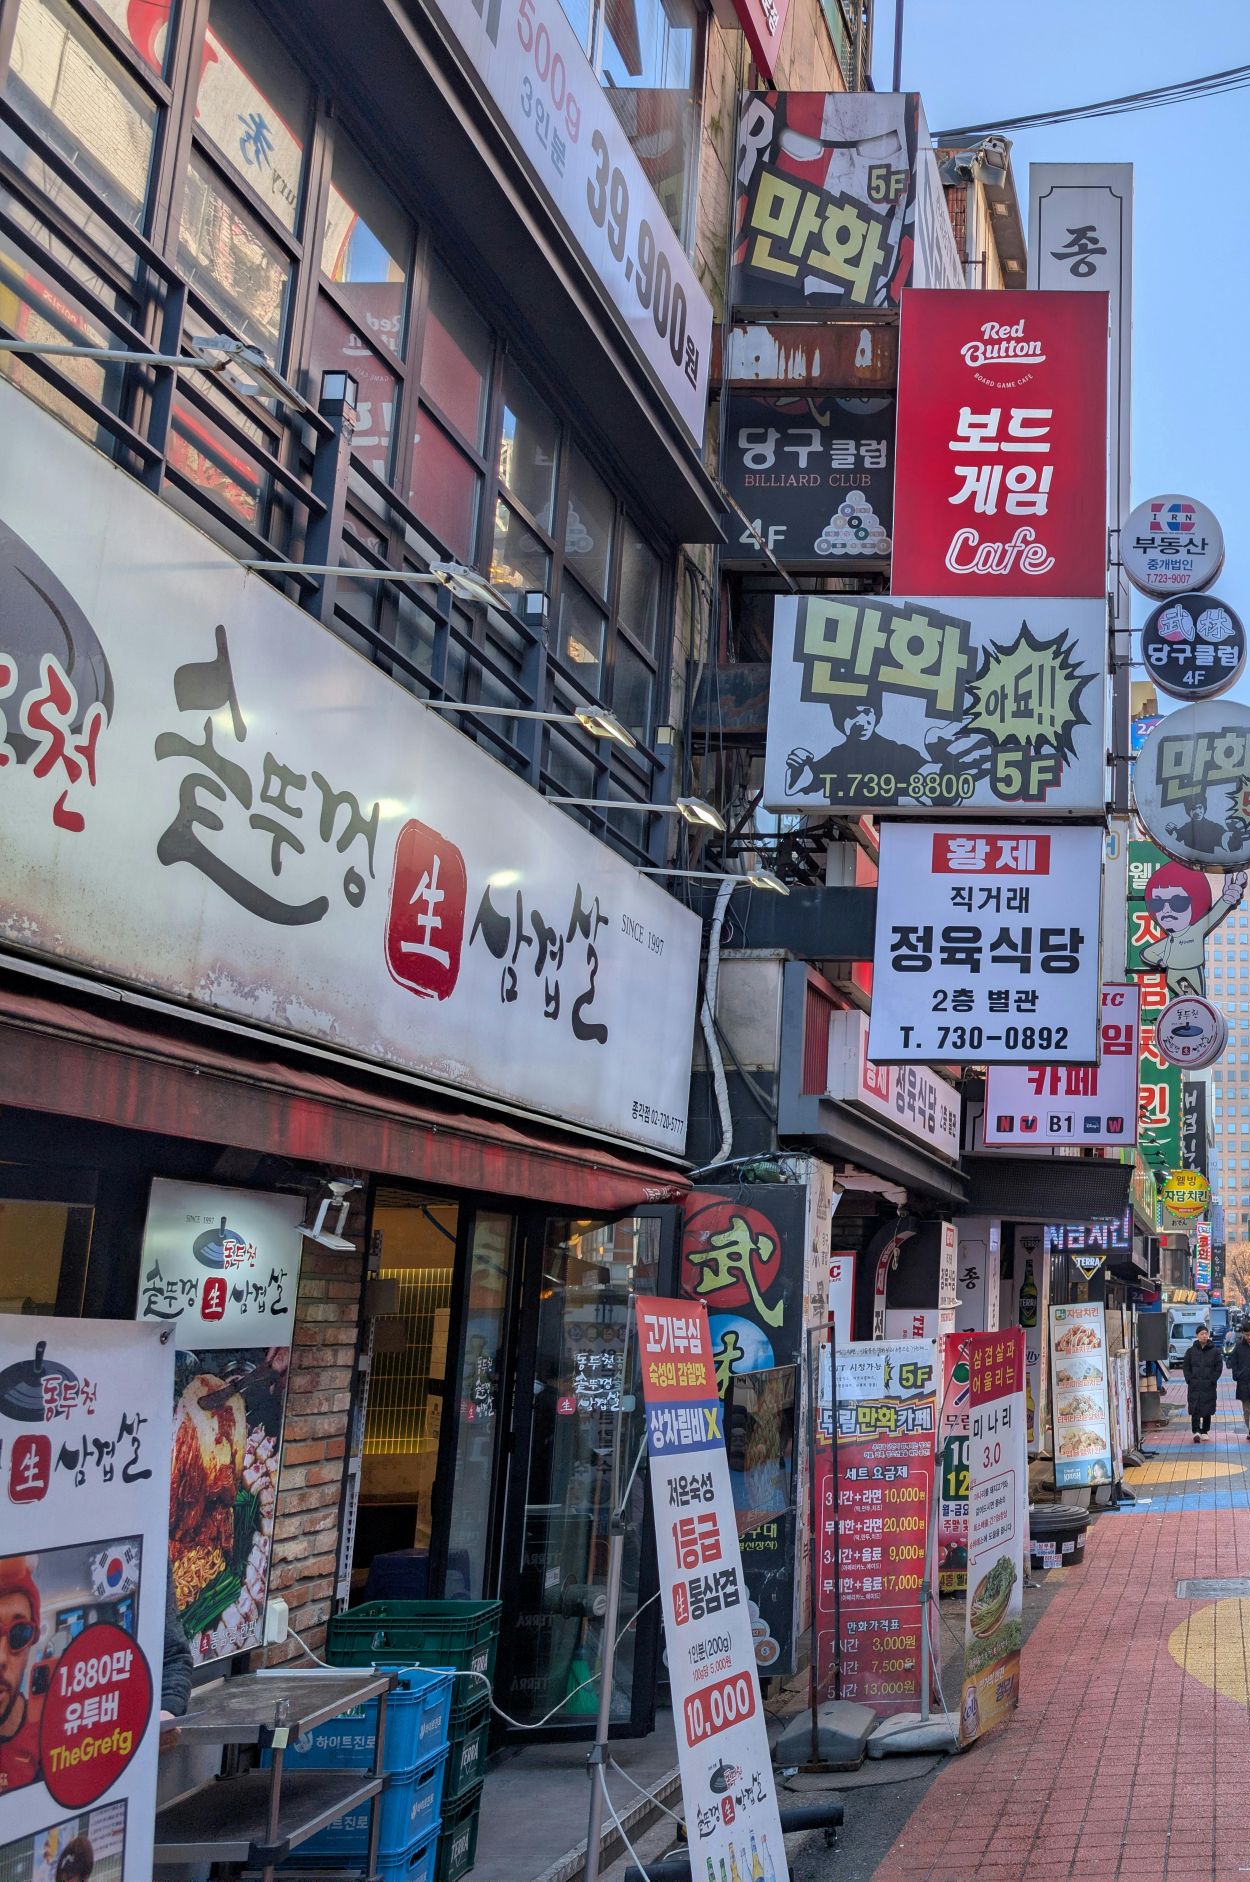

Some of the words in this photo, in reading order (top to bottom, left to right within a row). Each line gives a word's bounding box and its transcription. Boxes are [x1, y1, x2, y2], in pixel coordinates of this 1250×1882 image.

[868, 166, 906, 199] 5F
[751, 171, 885, 304] 만화
[980, 319, 1025, 340] Red
[960, 339, 1047, 367] Button
[974, 372, 996, 388] BOARD
[996, 380, 1016, 389] GAME
[1014, 373, 1034, 388] CAFE
[949, 406, 1053, 453] 보드
[745, 474, 820, 487] BILLIARD
[829, 474, 871, 487] CLUB
[949, 465, 1054, 516] 게임
[739, 518, 787, 551] 4F
[1133, 536, 1208, 556] 부동산
[945, 527, 1055, 574] Cafe
[1147, 558, 1193, 571] 중개법인
[1146, 573, 1191, 585] T.723-9007
[803, 597, 968, 711] 만화
[1148, 644, 1239, 667] 당구클럽
[1183, 670, 1206, 685] 4F
[820, 773, 974, 798] T.739-8800
[998, 752, 1058, 796] 5F
[154, 624, 380, 926] 솥뚜껑
[402, 855, 451, 966] 生
[469, 883, 608, 1044] 삼겹살
[946, 838, 1037, 871] 황제
[950, 887, 1031, 914] 직거래
[621, 914, 644, 945] SINCE
[647, 933, 665, 957] 1997
[890, 925, 1085, 974] 정육식당
[931, 989, 975, 1013] 2층
[988, 989, 1039, 1013] 별관
[937, 1026, 1069, 1050] 730-0892
[1028, 1066, 1098, 1096] 카페
[632, 1100, 651, 1123] 종각점
[651, 1107, 684, 1135] 02-720-5777
[1050, 1116, 1072, 1132] B1
[1165, 1190, 1208, 1202] 자담치킨
[223, 1240, 258, 1268] 동두천
[1077, 1257, 1101, 1267] TERRA
[143, 1260, 199, 1320] 솥뚜껑
[205, 1283, 223, 1314] 生
[230, 1268, 288, 1316] 삼겹살
[1067, 1308, 1100, 1318] 자담치킨
[644, 1314, 702, 1354] 고기부심
[973, 1342, 1015, 1368] 삼겹살과
[650, 1362, 676, 1387] 숙성의
[678, 1362, 706, 1387] 감칠맛
[900, 1363, 933, 1388] 5F
[973, 1368, 1014, 1394] 어울리는
[42, 1374, 97, 1424] 동두천
[973, 1405, 1012, 1439] 미나리
[15, 1443, 45, 1491] 生
[55, 1412, 153, 1488] 삼겹살
[983, 1442, 1001, 1468] 3.0
[845, 1467, 869, 1480] 세트
[872, 1466, 908, 1480] 요금제
[667, 1472, 715, 1507] 저온숙성
[884, 1488, 925, 1502] 10,000원
[884, 1517, 925, 1532] 20,000원
[672, 1512, 722, 1569] 1등급
[889, 1546, 924, 1560] 9,000원
[689, 1567, 740, 1620] 통삼겹
[847, 1619, 899, 1632] 만화가격표
[688, 1631, 732, 1665] 1인분(200g)
[873, 1635, 915, 1651] 3,000원
[59, 1649, 133, 1697] 1,880만
[711, 1656, 732, 1676] 5,000원
[864, 1681, 914, 1695] 13,000원
[64, 1692, 120, 1736] 유투버
[687, 1679, 749, 1741] 10,000
[50, 1728, 133, 1772] TheGrefg
[316, 1736, 376, 1749] 하이트진로
